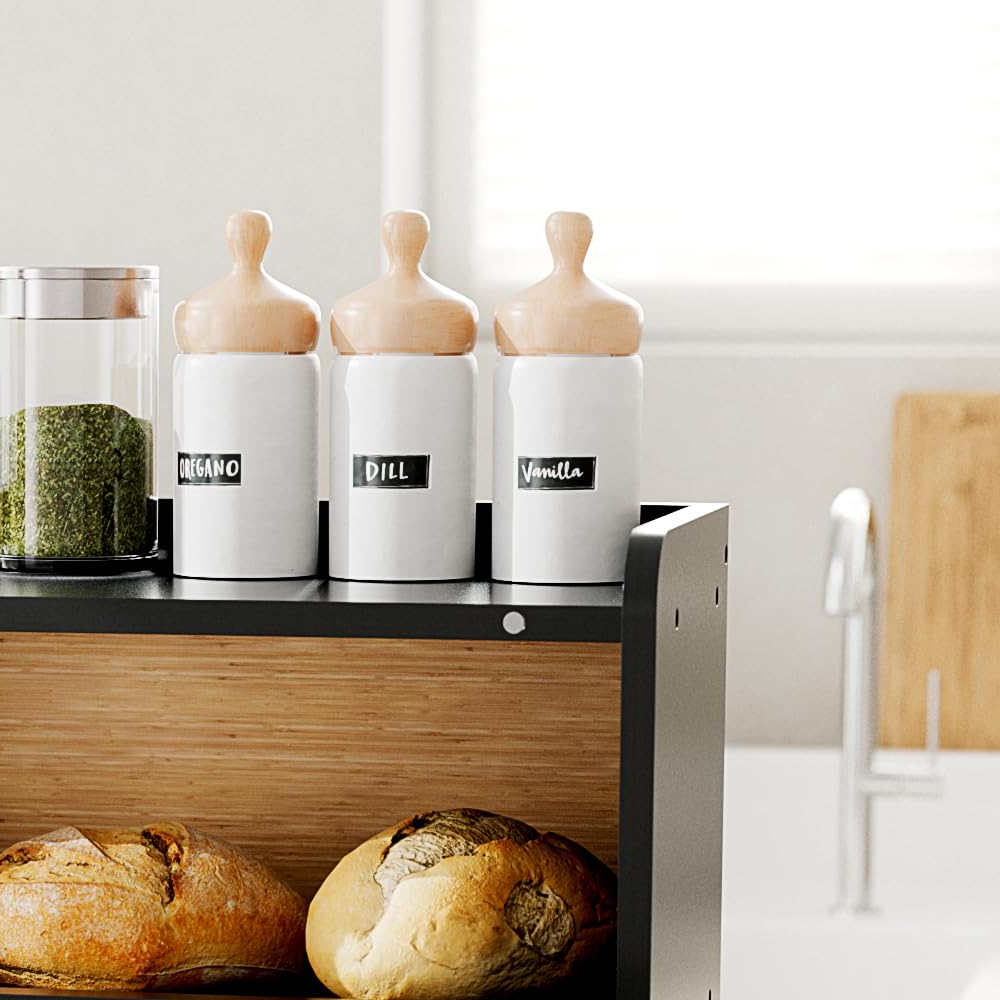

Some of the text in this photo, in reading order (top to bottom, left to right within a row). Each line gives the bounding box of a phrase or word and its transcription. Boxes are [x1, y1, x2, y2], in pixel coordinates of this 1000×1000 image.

[179, 457, 239, 480] OREGANO
[365, 460, 409, 481] DILL
[521, 460, 584, 483] Vanilla
